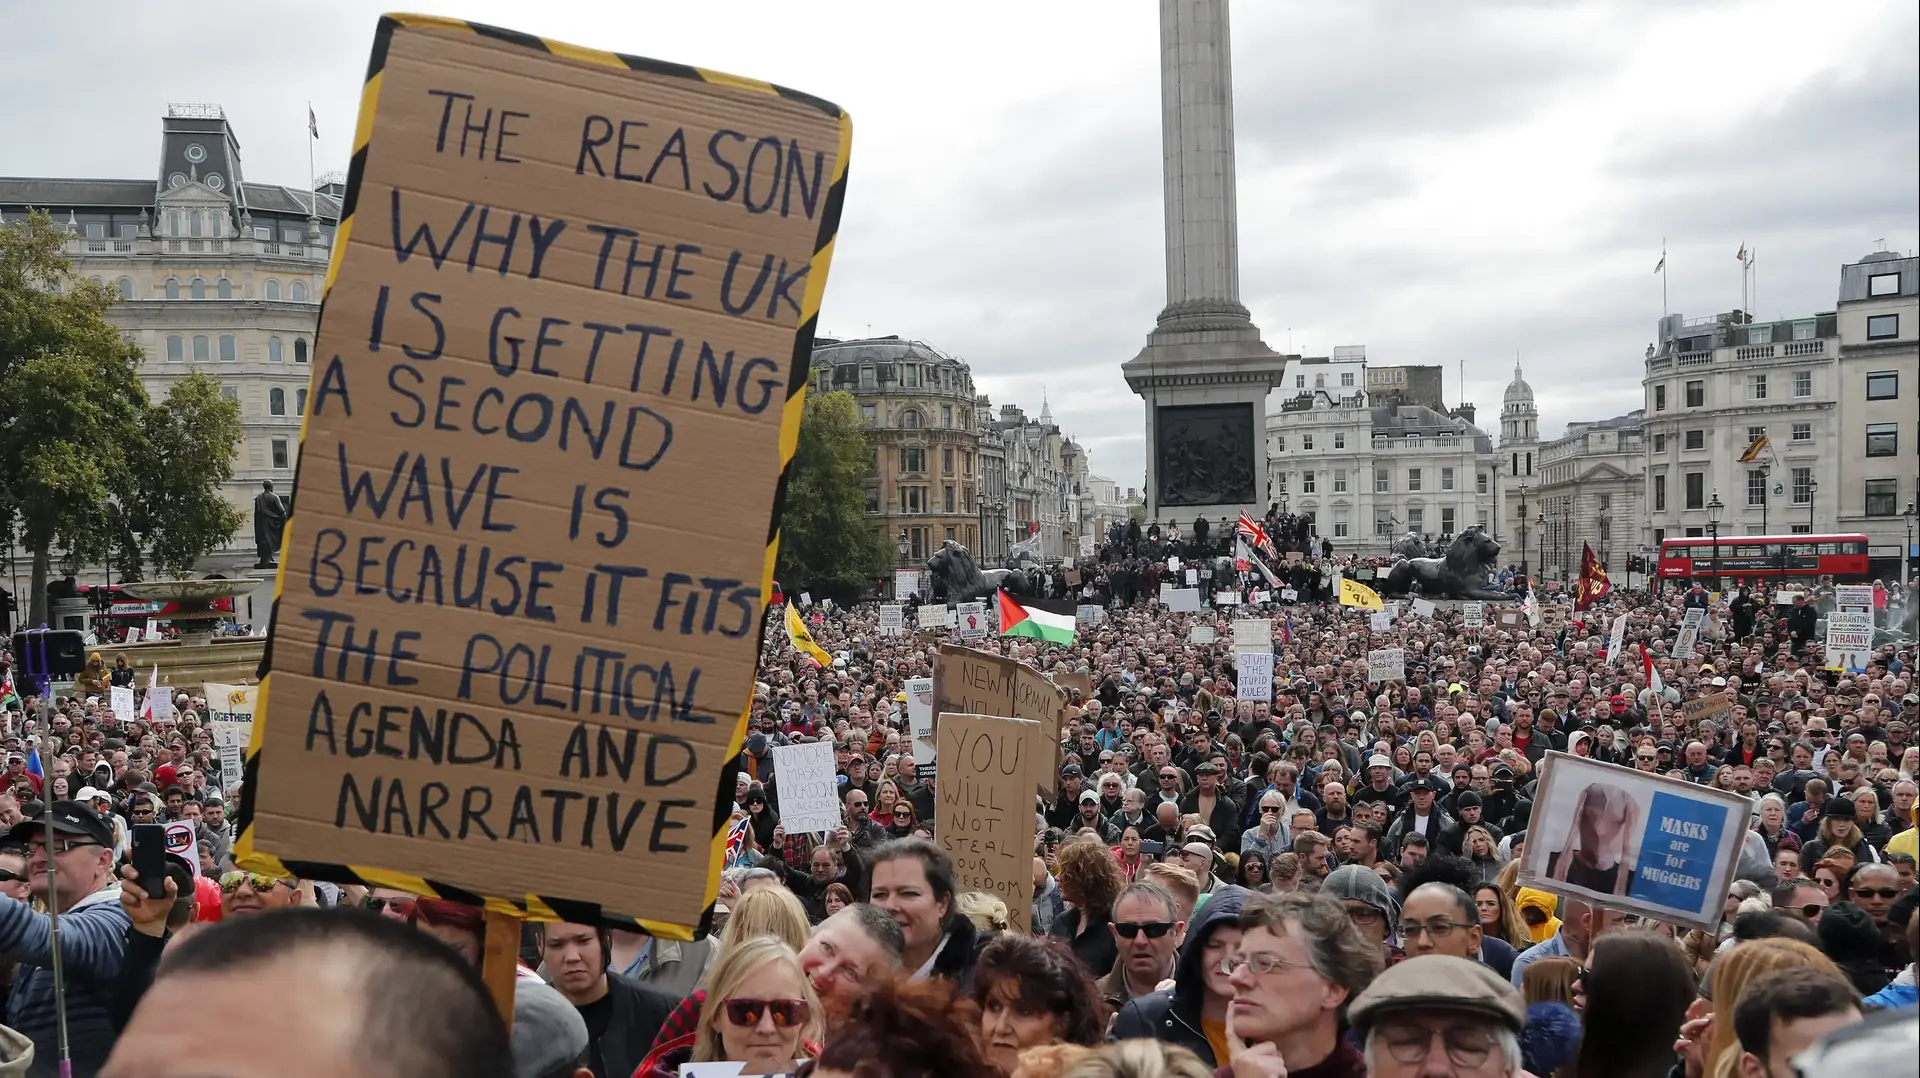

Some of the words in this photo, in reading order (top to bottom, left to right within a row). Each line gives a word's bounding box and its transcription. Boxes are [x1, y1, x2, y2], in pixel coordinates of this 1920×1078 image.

[428, 90, 530, 164] THE
[576, 115, 824, 220] REASON
[391, 187, 566, 279] WHY
[586, 224, 702, 300] THE
[720, 250, 812, 319] UK
[368, 285, 446, 361] IS
[489, 307, 783, 414] GETTING
[314, 355, 352, 417] A
[388, 364, 673, 470] SECOND
[338, 441, 520, 532] WAVE
[569, 484, 630, 548] IS
[309, 529, 563, 622] BECAUSE
[580, 564, 648, 626] IT
[653, 573, 761, 638] FITS
[1830, 615, 1871, 624] QUARANTINE
[1829, 634, 1869, 644] TYRANNY
[302, 608, 422, 685] THE
[457, 634, 715, 724] POLITICAL
[1240, 654, 1271, 665] STUFF
[1245, 666, 1265, 675] THE
[962, 661, 1001, 694] NEW
[1007, 673, 1054, 723] NORMAL
[1239, 676, 1268, 686] STUPID
[1241, 687, 1267, 697] RULES
[210, 708, 252, 722] TOGETHER
[306, 690, 522, 770] AGENDA
[559, 723, 697, 787] AND
[773, 748, 791, 767] NO
[793, 745, 832, 764] MORE
[949, 727, 1022, 776] YOU
[786, 765, 824, 783] MASKS
[65, 814, 80, 823] Jeep
[334, 773, 697, 854] NARRATIVE
[951, 812, 1002, 833] NOT
[1659, 816, 1709, 841] MASKS
[945, 834, 1015, 859] STEAL
[1669, 839, 1690, 853] are
[958, 858, 990, 875] OUR
[1665, 853, 1686, 870] for
[1640, 866, 1702, 892] MUGGERS
